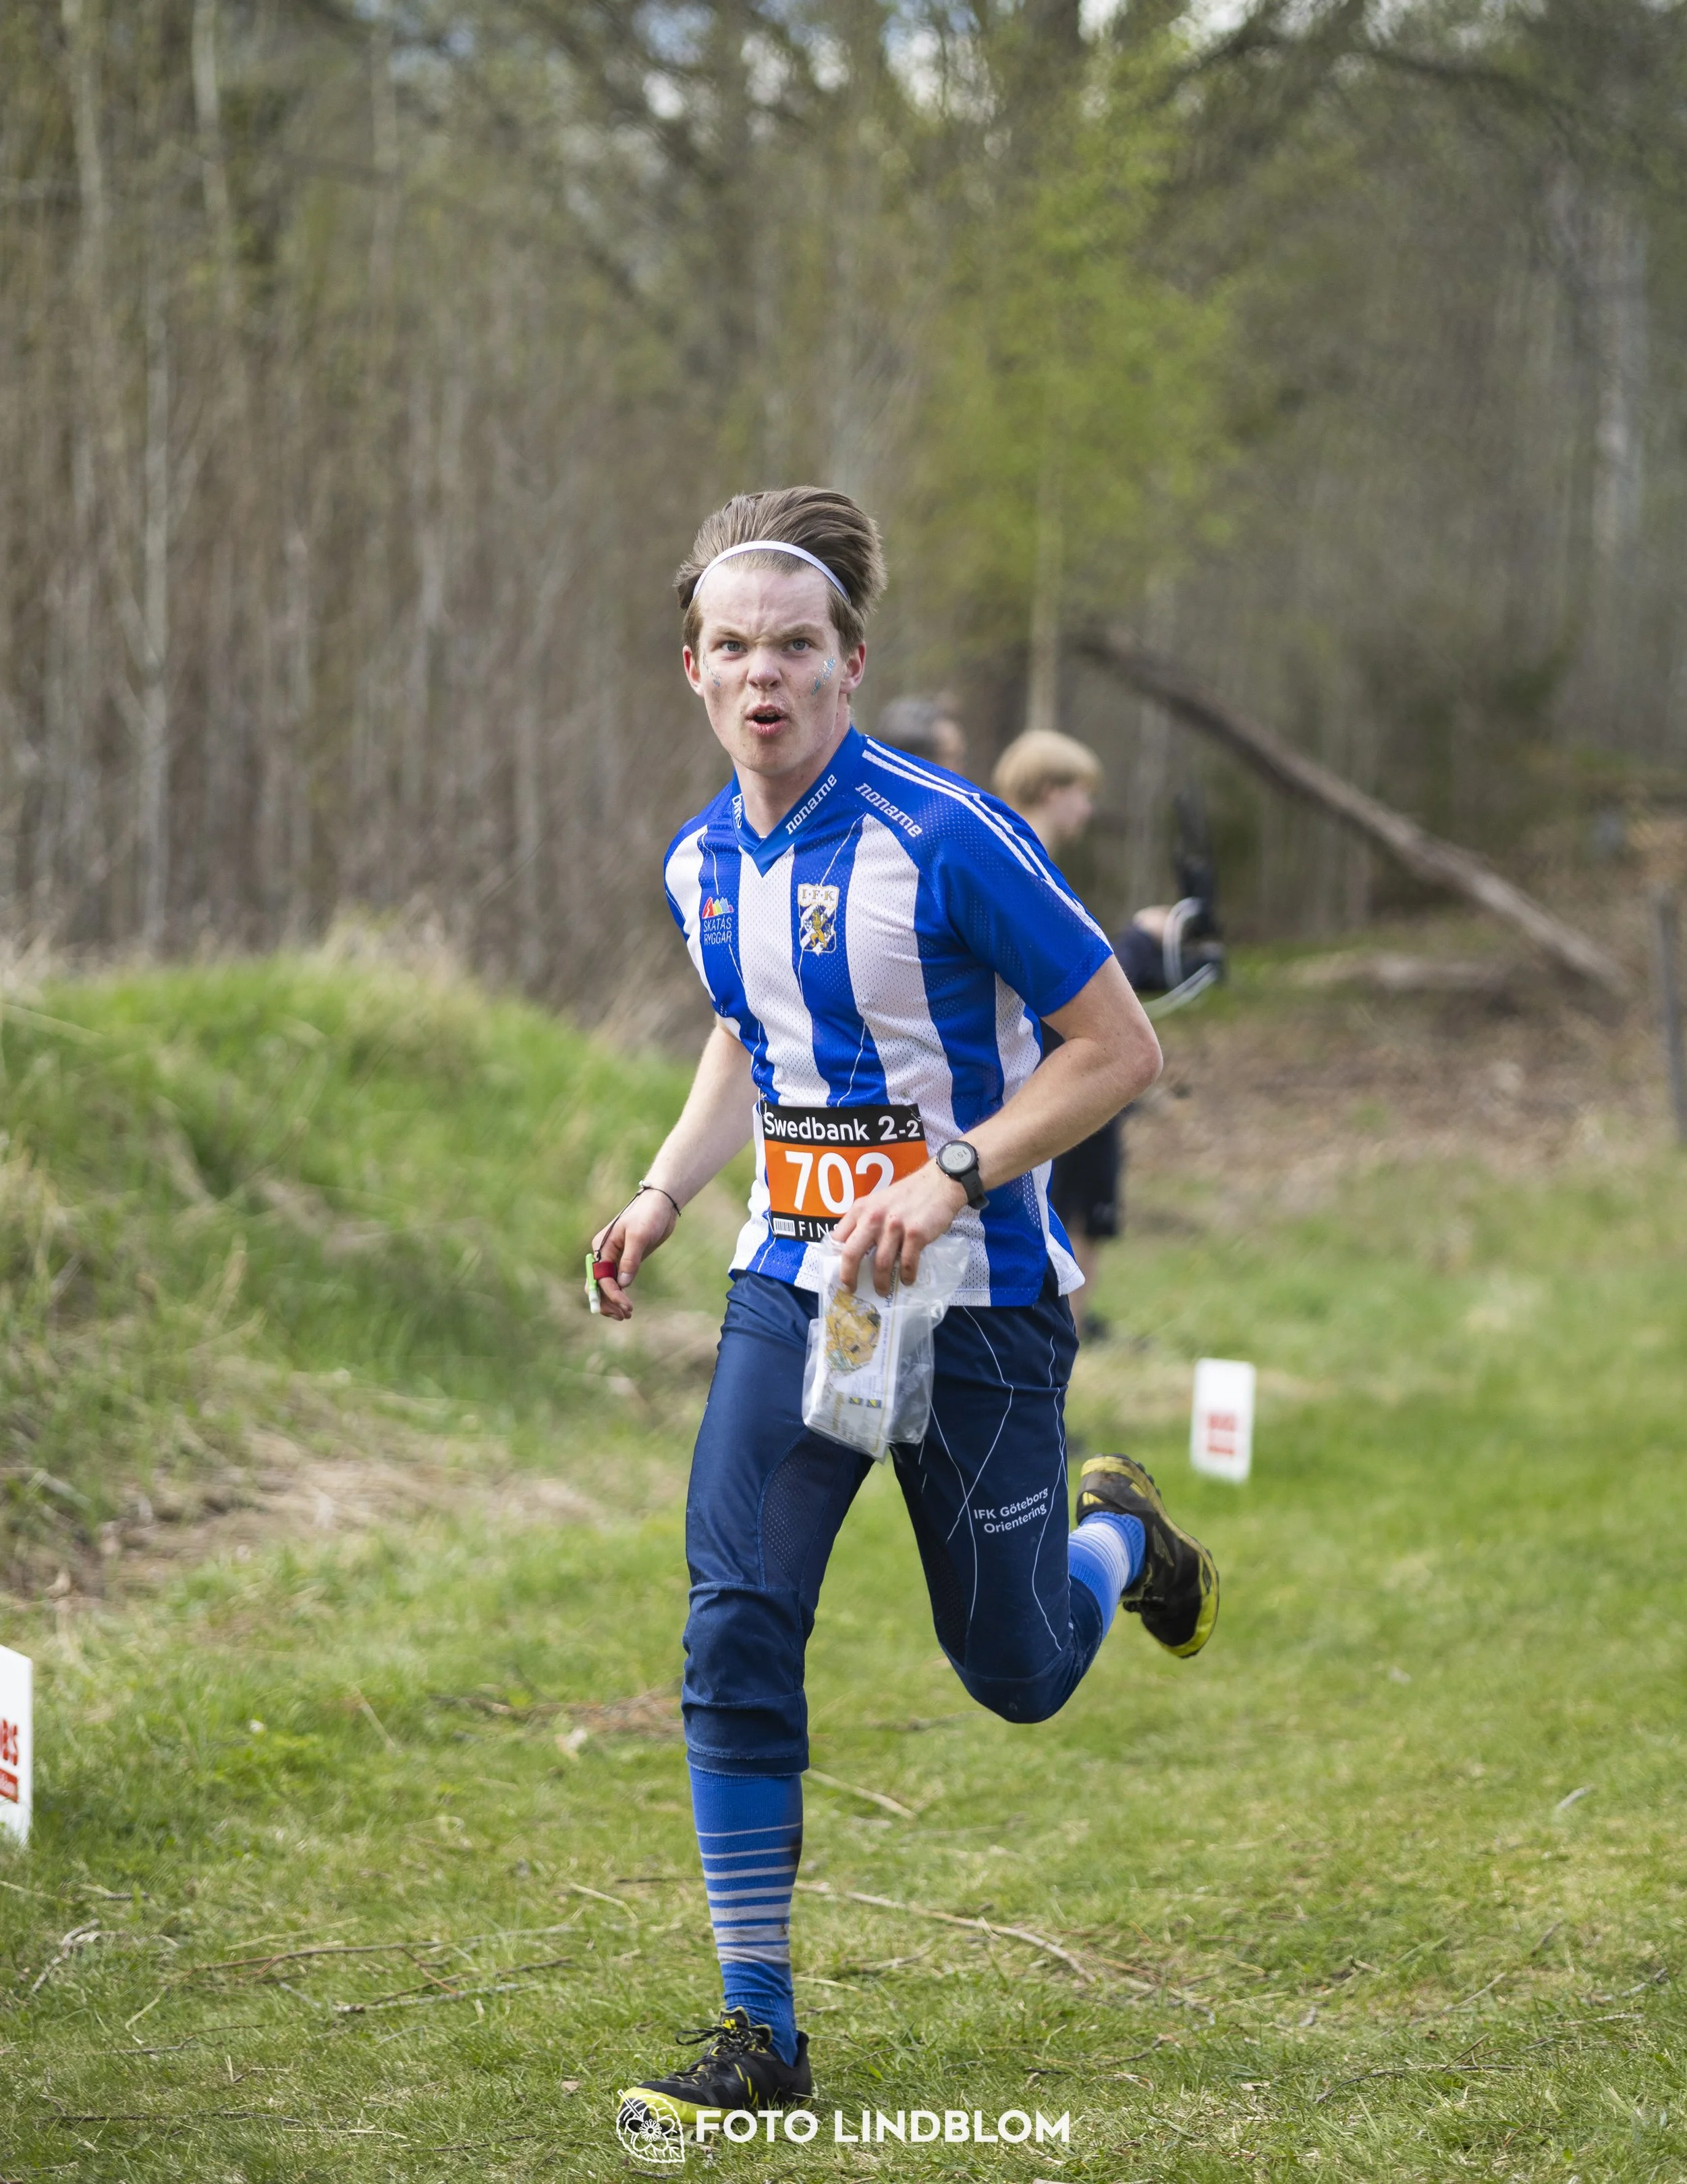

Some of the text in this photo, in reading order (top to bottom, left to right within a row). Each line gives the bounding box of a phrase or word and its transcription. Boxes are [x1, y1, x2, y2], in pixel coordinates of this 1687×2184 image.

[785, 774, 837, 835] noname
[855, 783, 922, 838] noname
[704, 931, 732, 946] RYGGAR
[764, 1112, 870, 1141] Swedbank
[785, 1150, 894, 1214] 702
[798, 1220, 839, 1238] FIN
[974, 1487, 1048, 1519] IFK Göteborg
[984, 1503, 1047, 1533] Orientering
